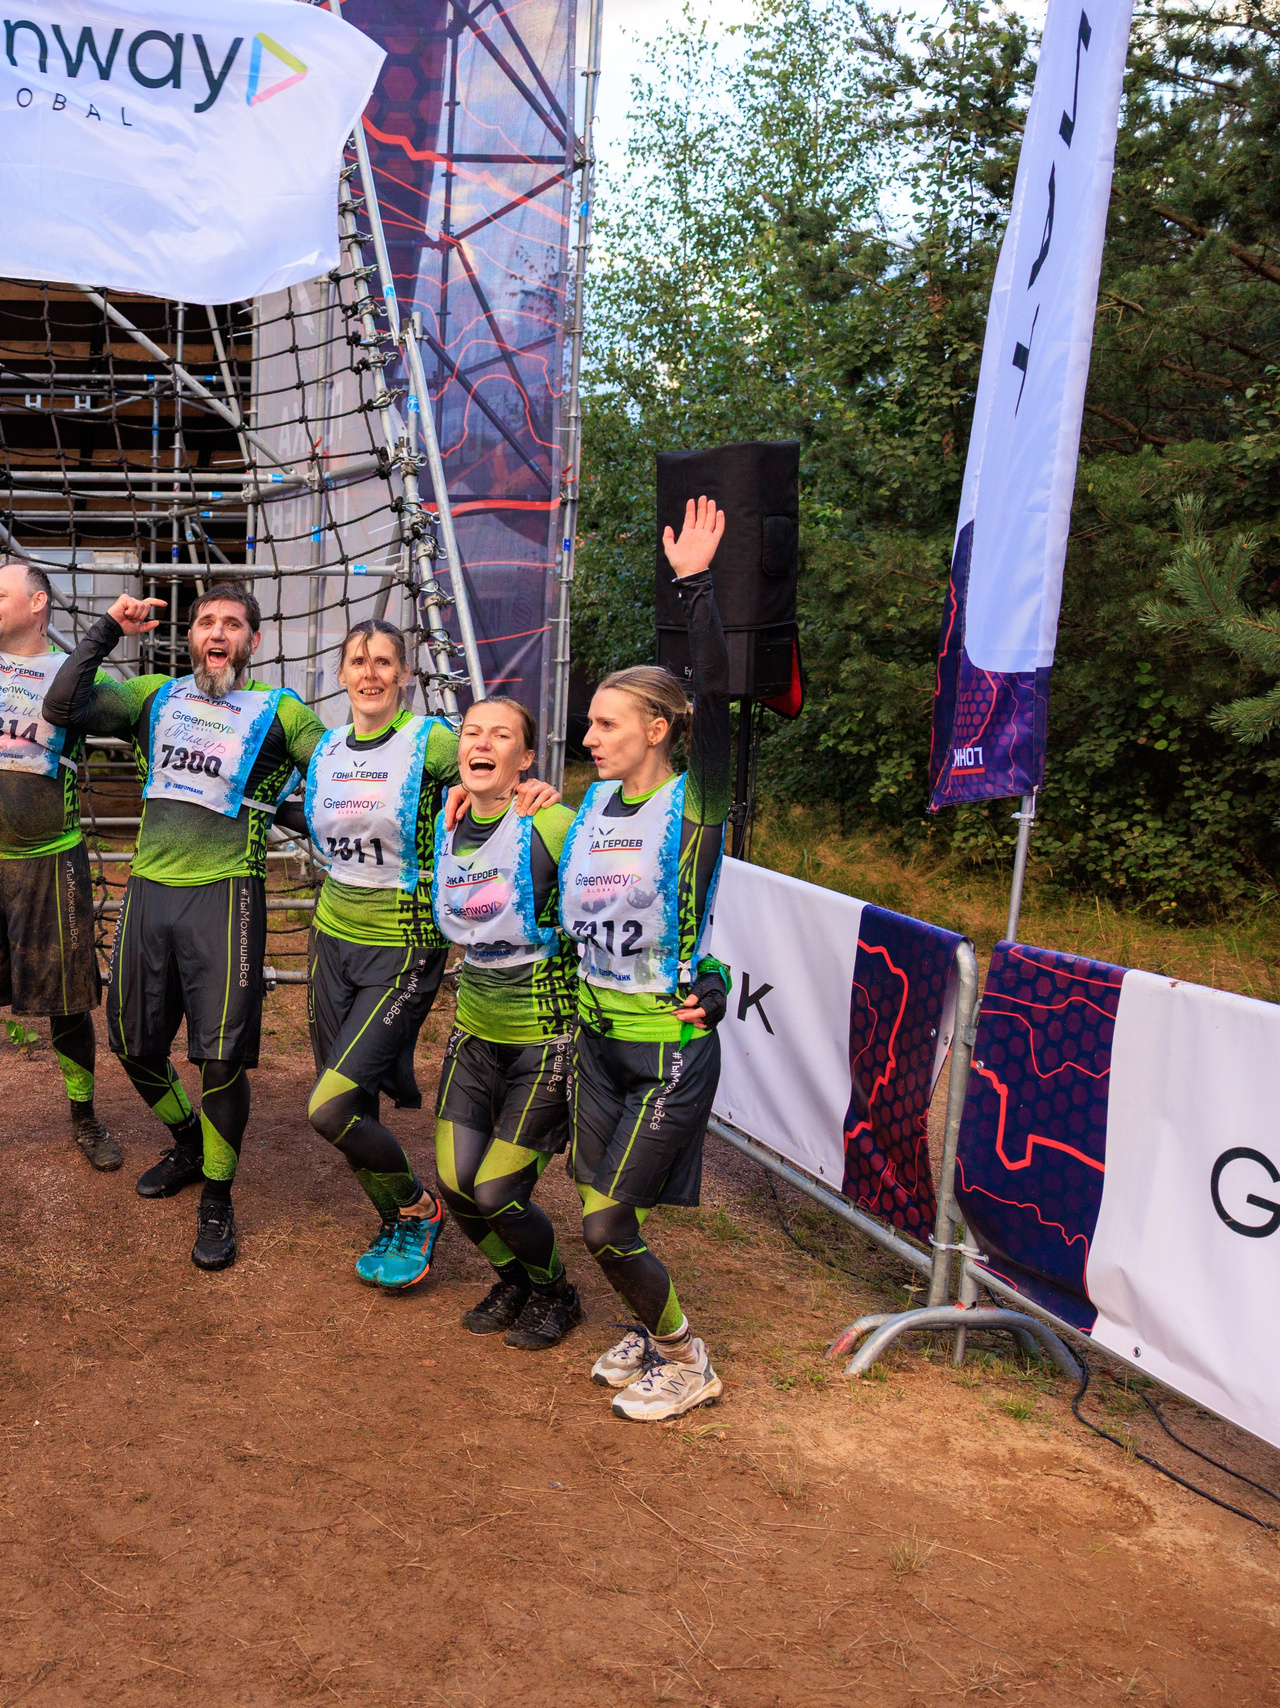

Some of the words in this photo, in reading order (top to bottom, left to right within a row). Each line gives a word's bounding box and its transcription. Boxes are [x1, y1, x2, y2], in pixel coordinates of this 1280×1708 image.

[172, 710, 228, 734] Greenway
[161, 744, 222, 778] 7300
[354, 770, 388, 779] ГЕРОЕВ
[323, 797, 377, 812] Greenway
[603, 839, 643, 849] ГЕРОЕВ
[467, 867, 498, 882] ГЕРОЕВ
[575, 873, 630, 891] Greenway
[66, 860, 79, 950] #ТыМожешьВсё
[239, 887, 250, 988] #ТыМожешьВсё
